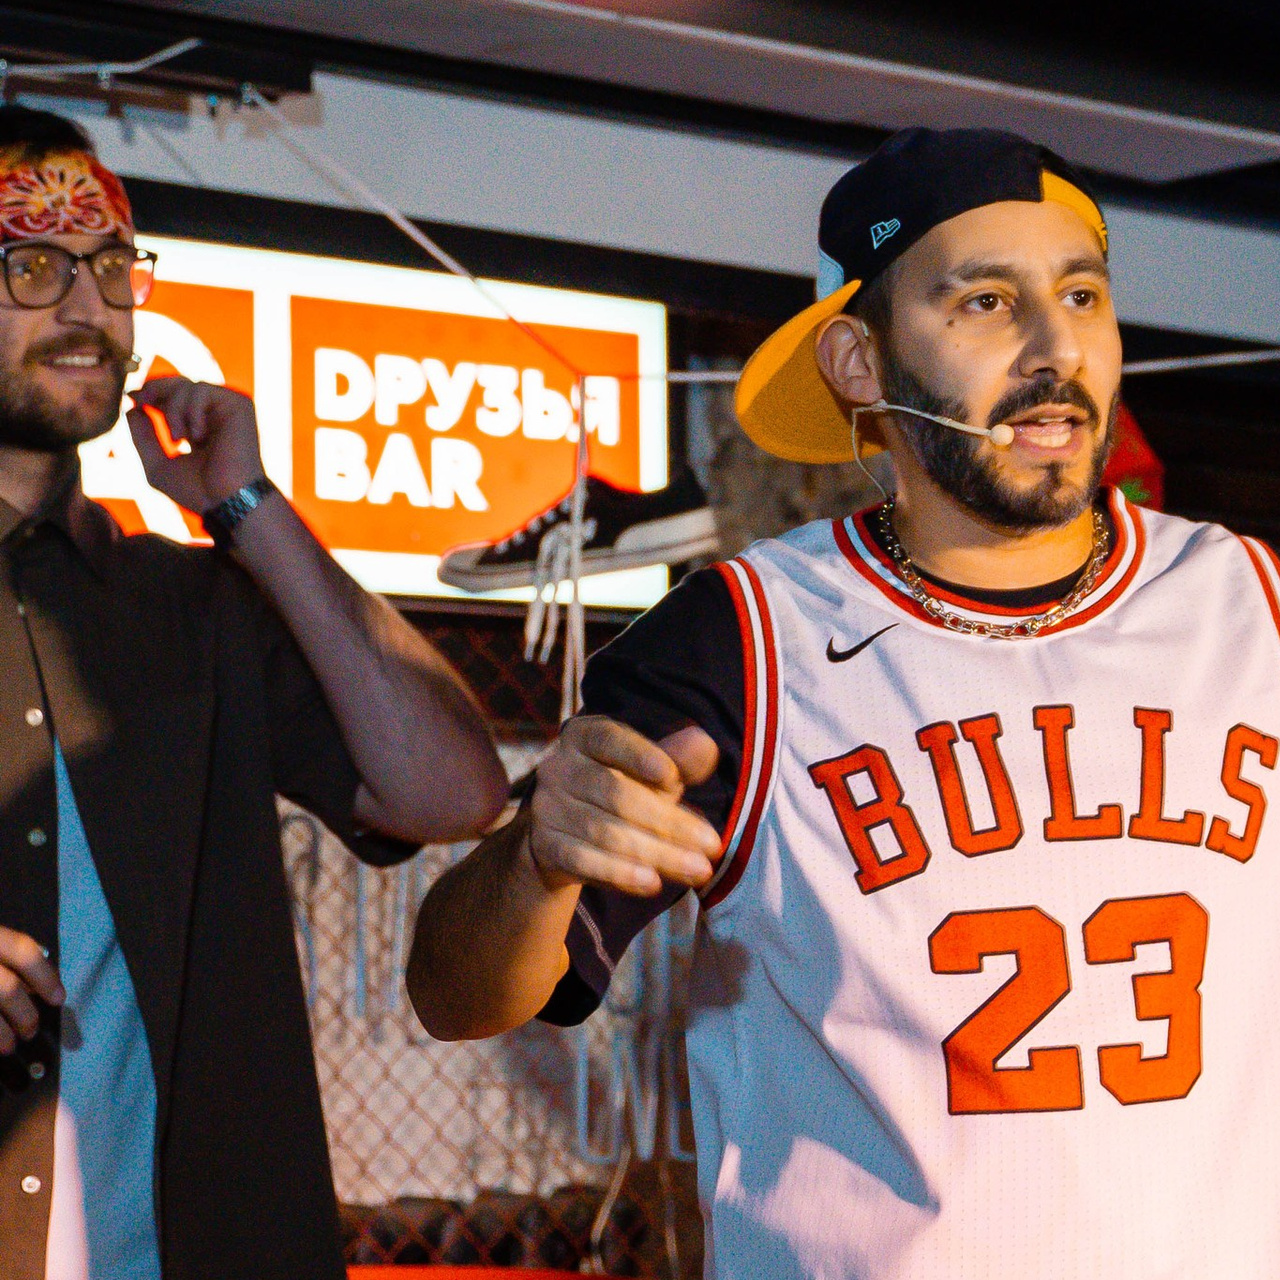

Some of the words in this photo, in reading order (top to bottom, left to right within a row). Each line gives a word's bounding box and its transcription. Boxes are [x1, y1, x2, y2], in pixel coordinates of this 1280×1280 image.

[313, 427, 489, 512] BAR
[807, 703, 1280, 895] BULLS
[927, 891, 1211, 1116] 23
